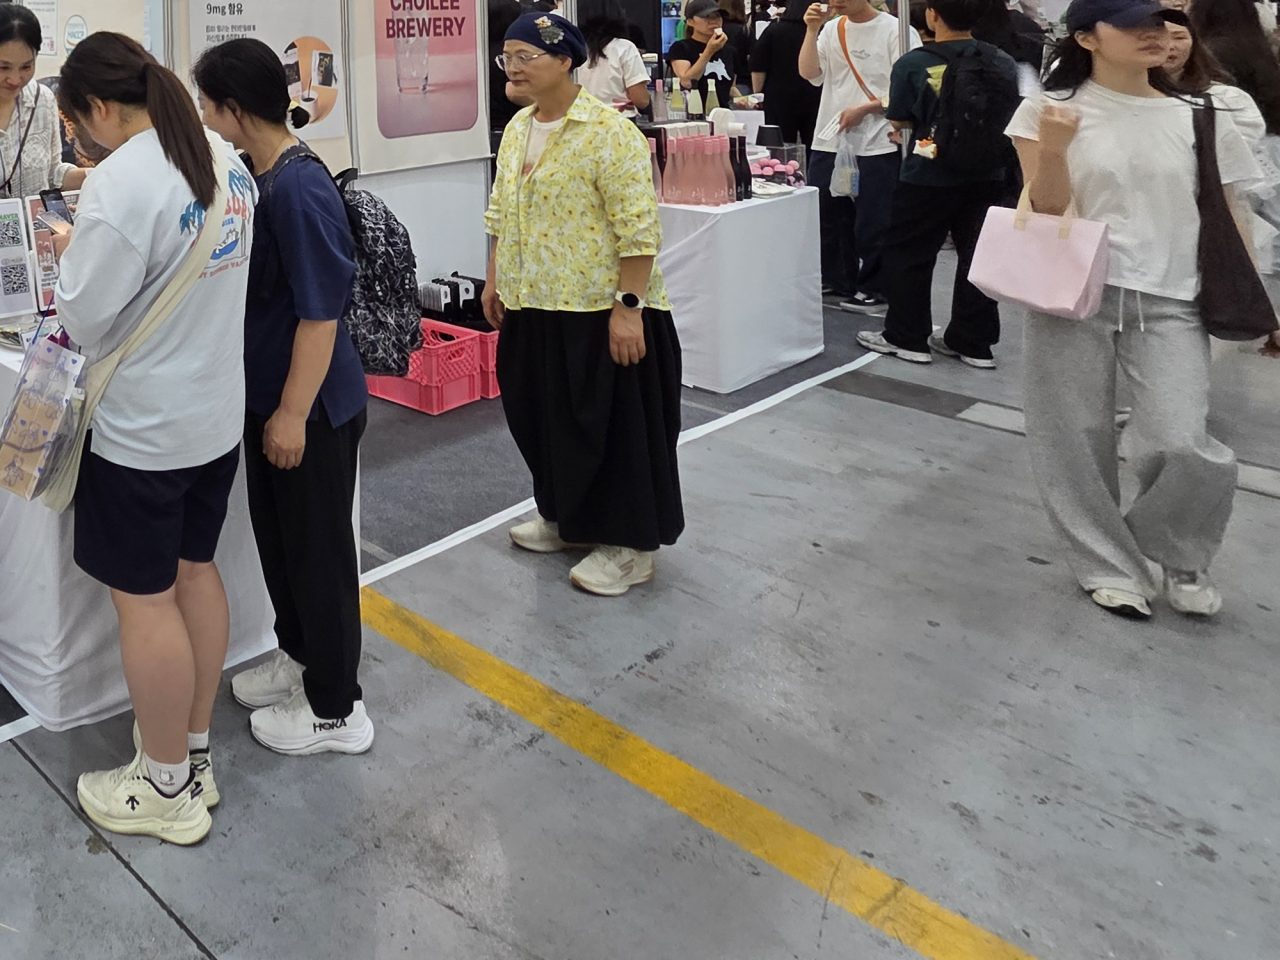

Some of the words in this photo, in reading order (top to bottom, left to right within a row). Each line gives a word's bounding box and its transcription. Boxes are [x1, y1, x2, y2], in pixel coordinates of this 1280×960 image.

[206, 3, 226, 16] 9mg
[386, 17, 466, 38] BREWERY
[313, 718, 347, 733] HOKA
